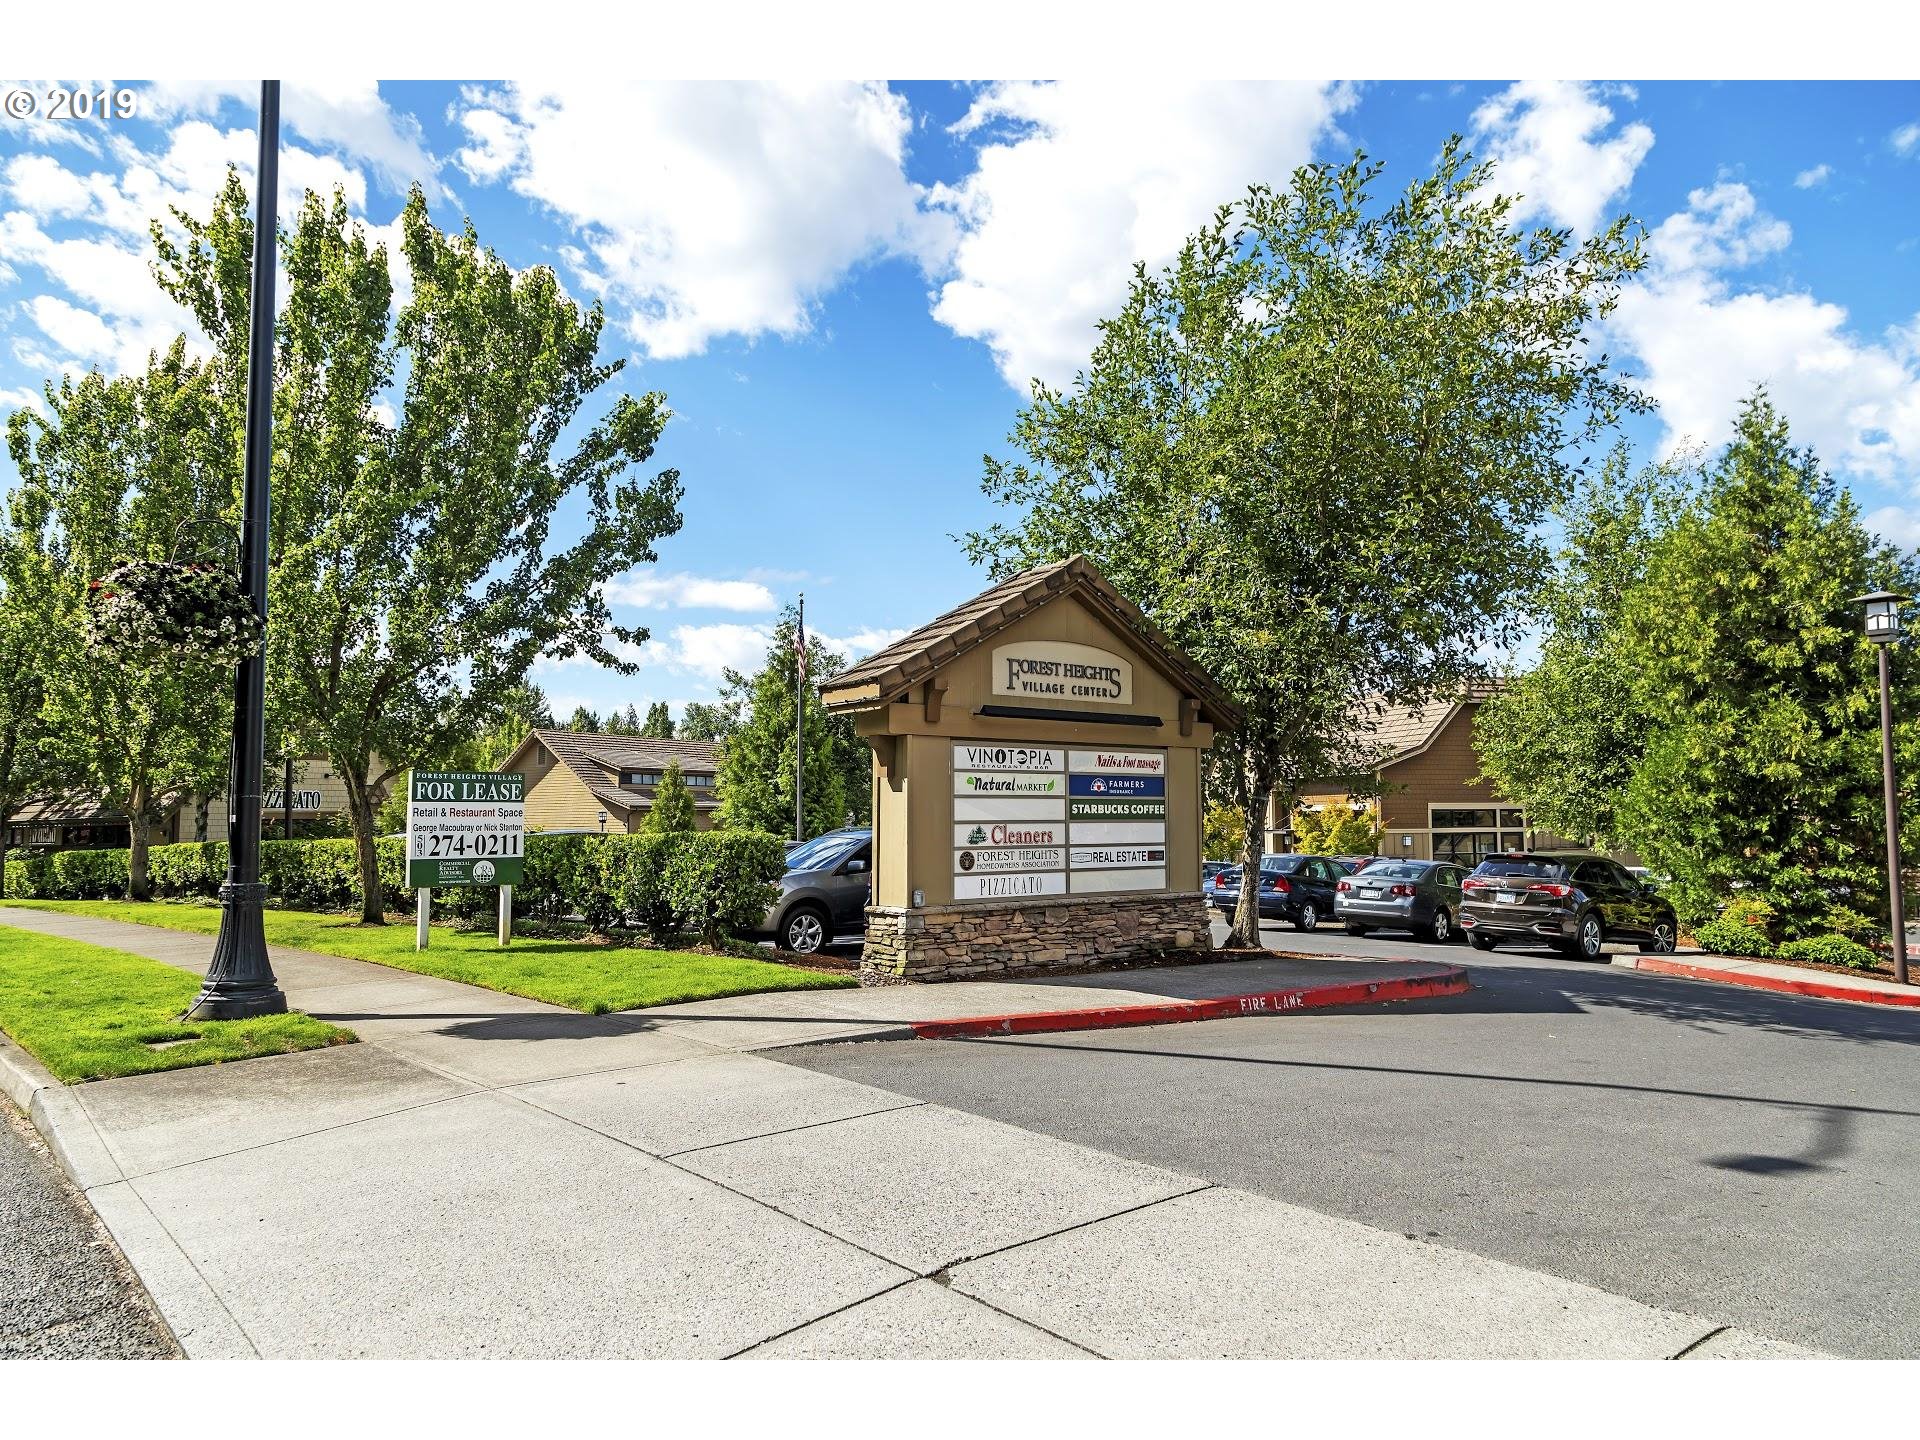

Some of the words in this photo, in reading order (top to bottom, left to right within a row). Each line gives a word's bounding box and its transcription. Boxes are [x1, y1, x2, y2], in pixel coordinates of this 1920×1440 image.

[1006, 658, 1062, 690] FOREST
[1063, 663, 1122, 699] HEIGHTS
[1022, 681, 1065, 694] VILLAGE
[1071, 685, 1108, 697] CENTER
[966, 748, 1053, 766] VINOTOPIA
[1095, 755, 1117, 768] Nails
[1122, 756, 1137, 768] Foot
[1136, 758, 1161, 772] massage
[1016, 783, 1047, 791] MARKET
[1109, 780, 1145, 788] FARMERS
[415, 782, 456, 800] FOR
[461, 782, 523, 801] LEASE
[412, 807, 438, 817] Retail
[440, 808, 447, 817] &
[449, 807, 496, 817] Restaurant
[497, 808, 523, 819] Space
[1071, 804, 1130, 815] STARBUCKS
[1131, 804, 1165, 815] COFFEE
[412, 824, 438, 833] George
[439, 824, 474, 833] Macoubray
[475, 824, 482, 832] or
[484, 823, 498, 832] Nick
[499, 823, 523, 832] Stanton
[991, 824, 1053, 845] Cleaners
[428, 834, 519, 857] 274-0211
[977, 850, 1016, 862] FOREST
[1018, 849, 1059, 860] HEIGHTS
[1093, 851, 1115, 863] REAL
[1116, 851, 1147, 862] ESTATE
[976, 862, 1020, 870] HOMEOWNERS
[1021, 860, 1060, 868] ASSOCIATION
[980, 876, 1043, 896] PIZZICATO
